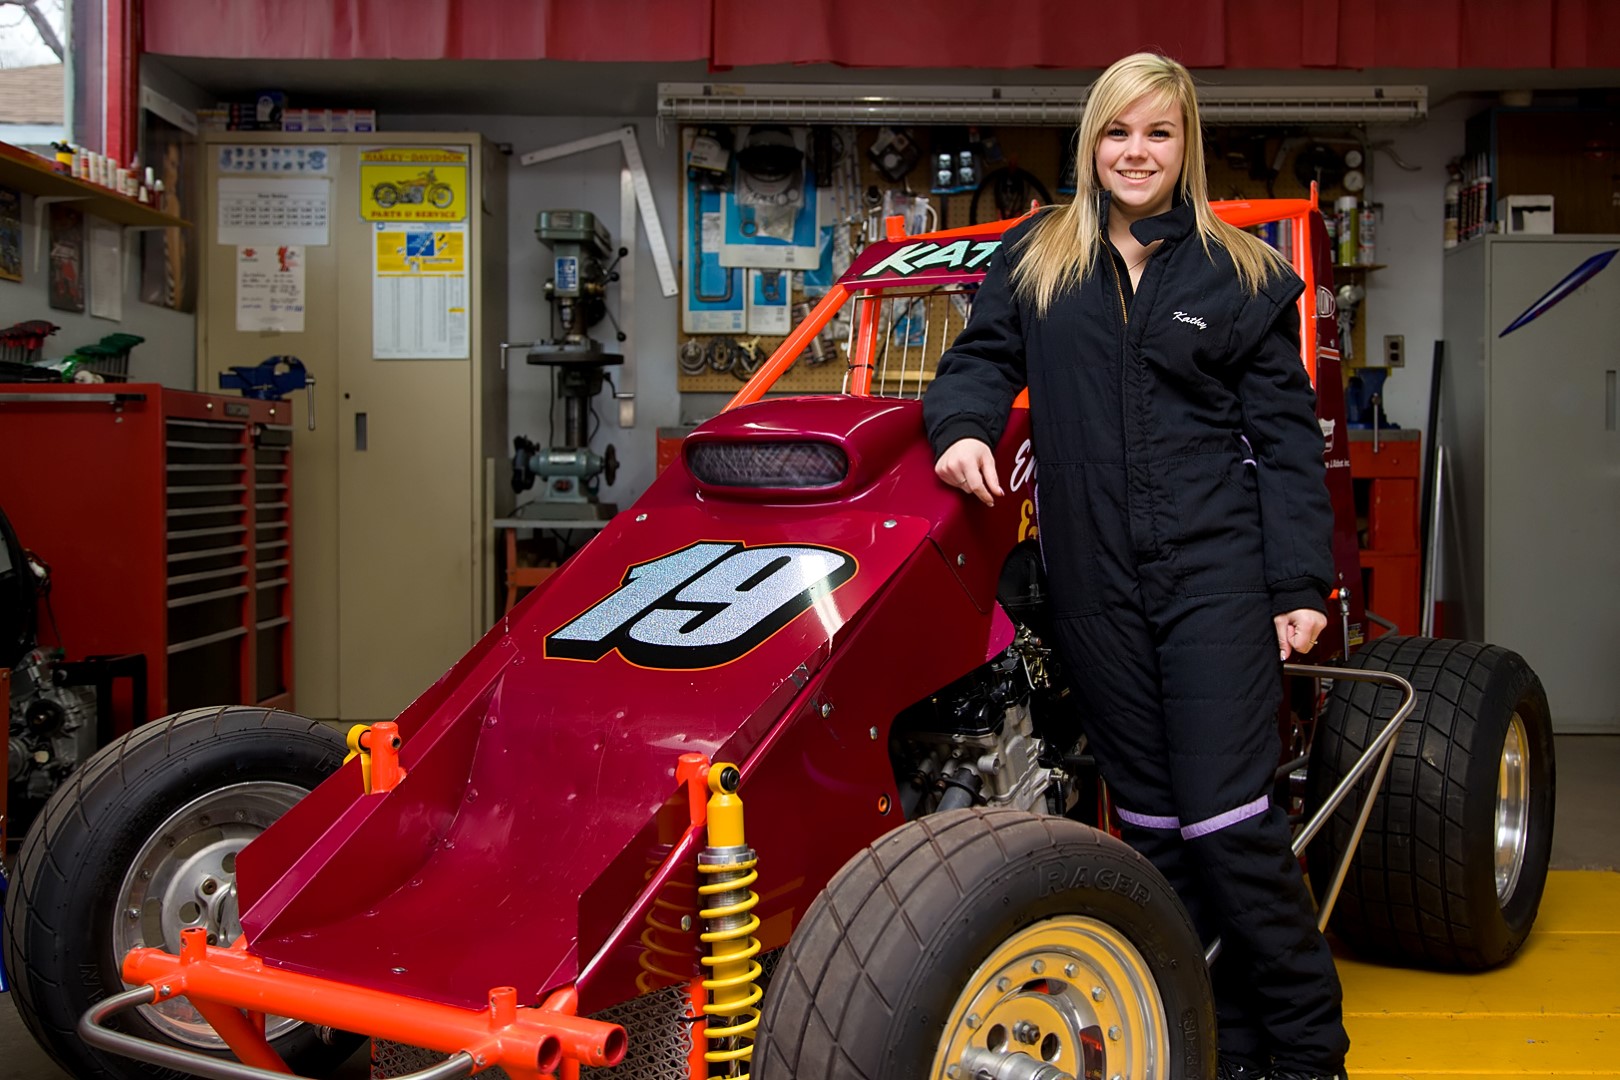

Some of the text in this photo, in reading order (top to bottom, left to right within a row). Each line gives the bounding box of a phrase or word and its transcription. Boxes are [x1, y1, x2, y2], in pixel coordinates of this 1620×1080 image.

[371, 210, 402, 219] PARTS
[415, 210, 457, 219] SERVICE
[860, 239, 1003, 277] KAT
[1172, 310, 1208, 330] Kathy
[544, 541, 855, 666] 19
[1038, 859, 1151, 908] RACER
